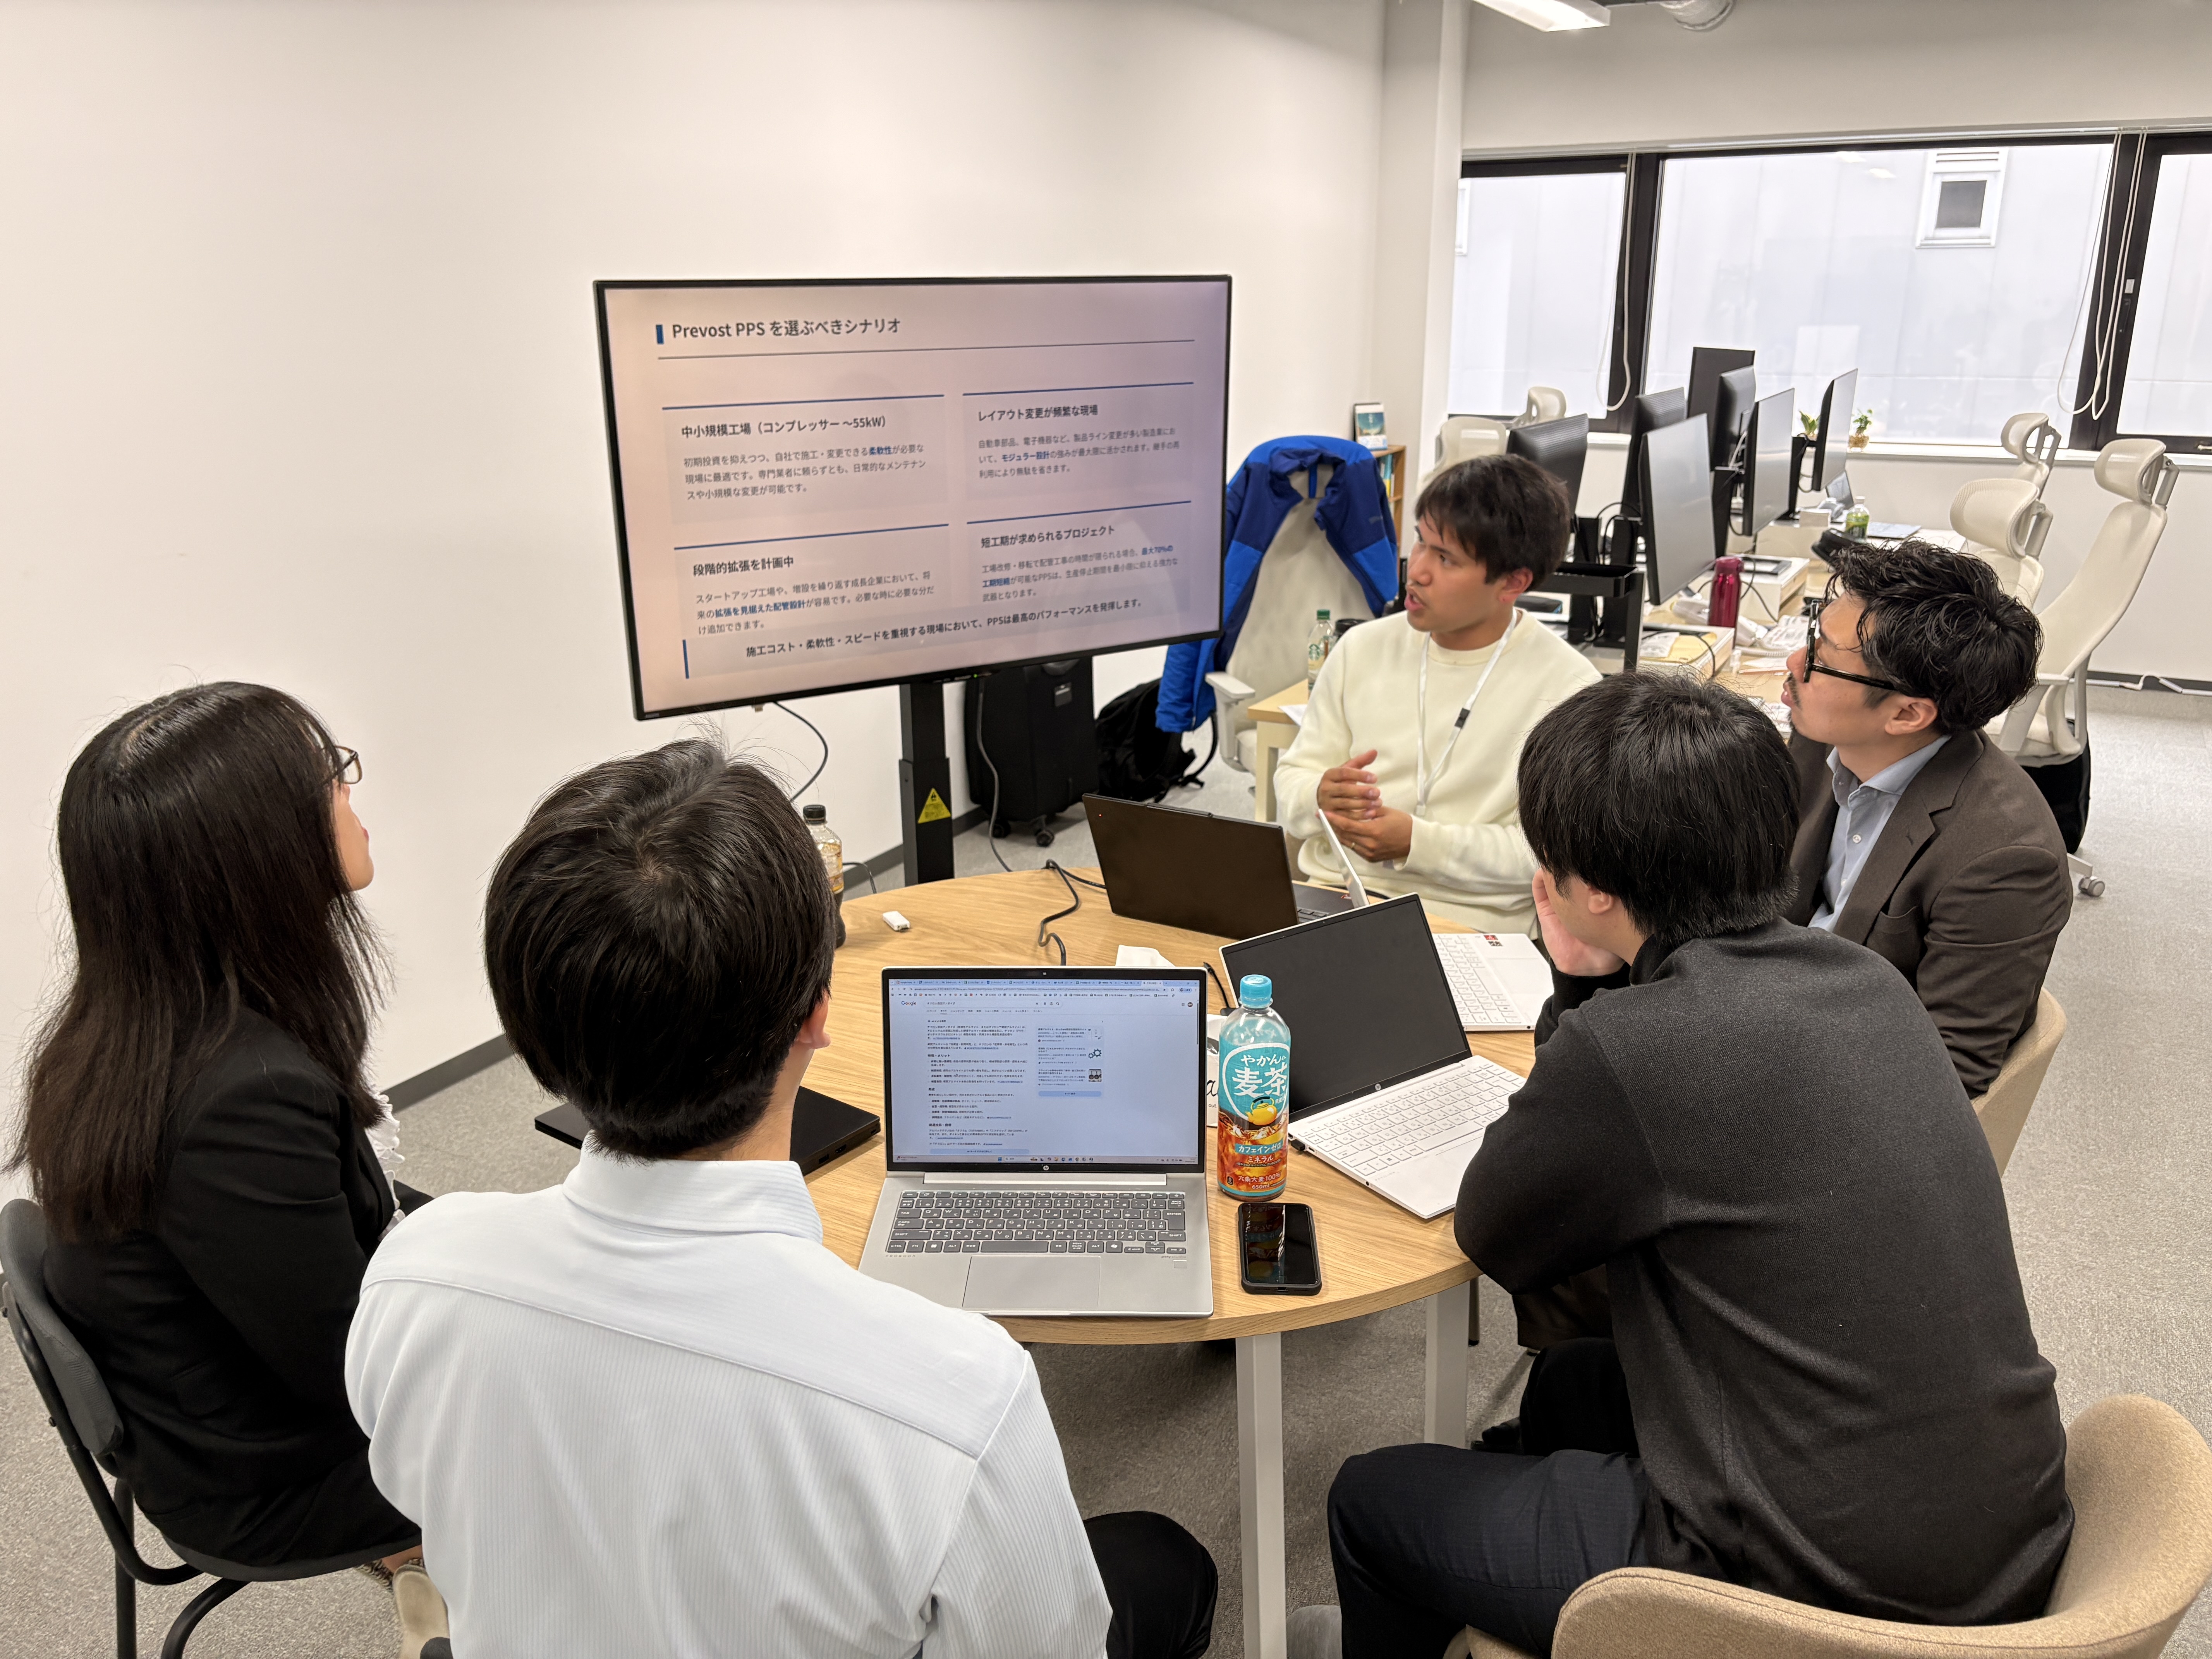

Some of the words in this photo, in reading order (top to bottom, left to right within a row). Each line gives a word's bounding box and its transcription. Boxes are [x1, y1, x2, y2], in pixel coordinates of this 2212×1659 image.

[672, 323, 732, 339] Prevost
[736, 322, 765, 337] PPS
[769, 318, 901, 337] を選ぶべきシナリオ
[687, 484, 808, 500] スや小規模な変更が可能です。
[981, 525, 1115, 548] 短工期が求められるプロジェクト
[693, 556, 794, 577] 段階的拡張を計画中
[698, 620, 764, 636] け追加できます。
[1232, 1062, 1288, 1099] 麦茶
[1239, 1142, 1281, 1153] カフェインゼロ
[1238, 1173, 1281, 1182] 六条大麦100%
